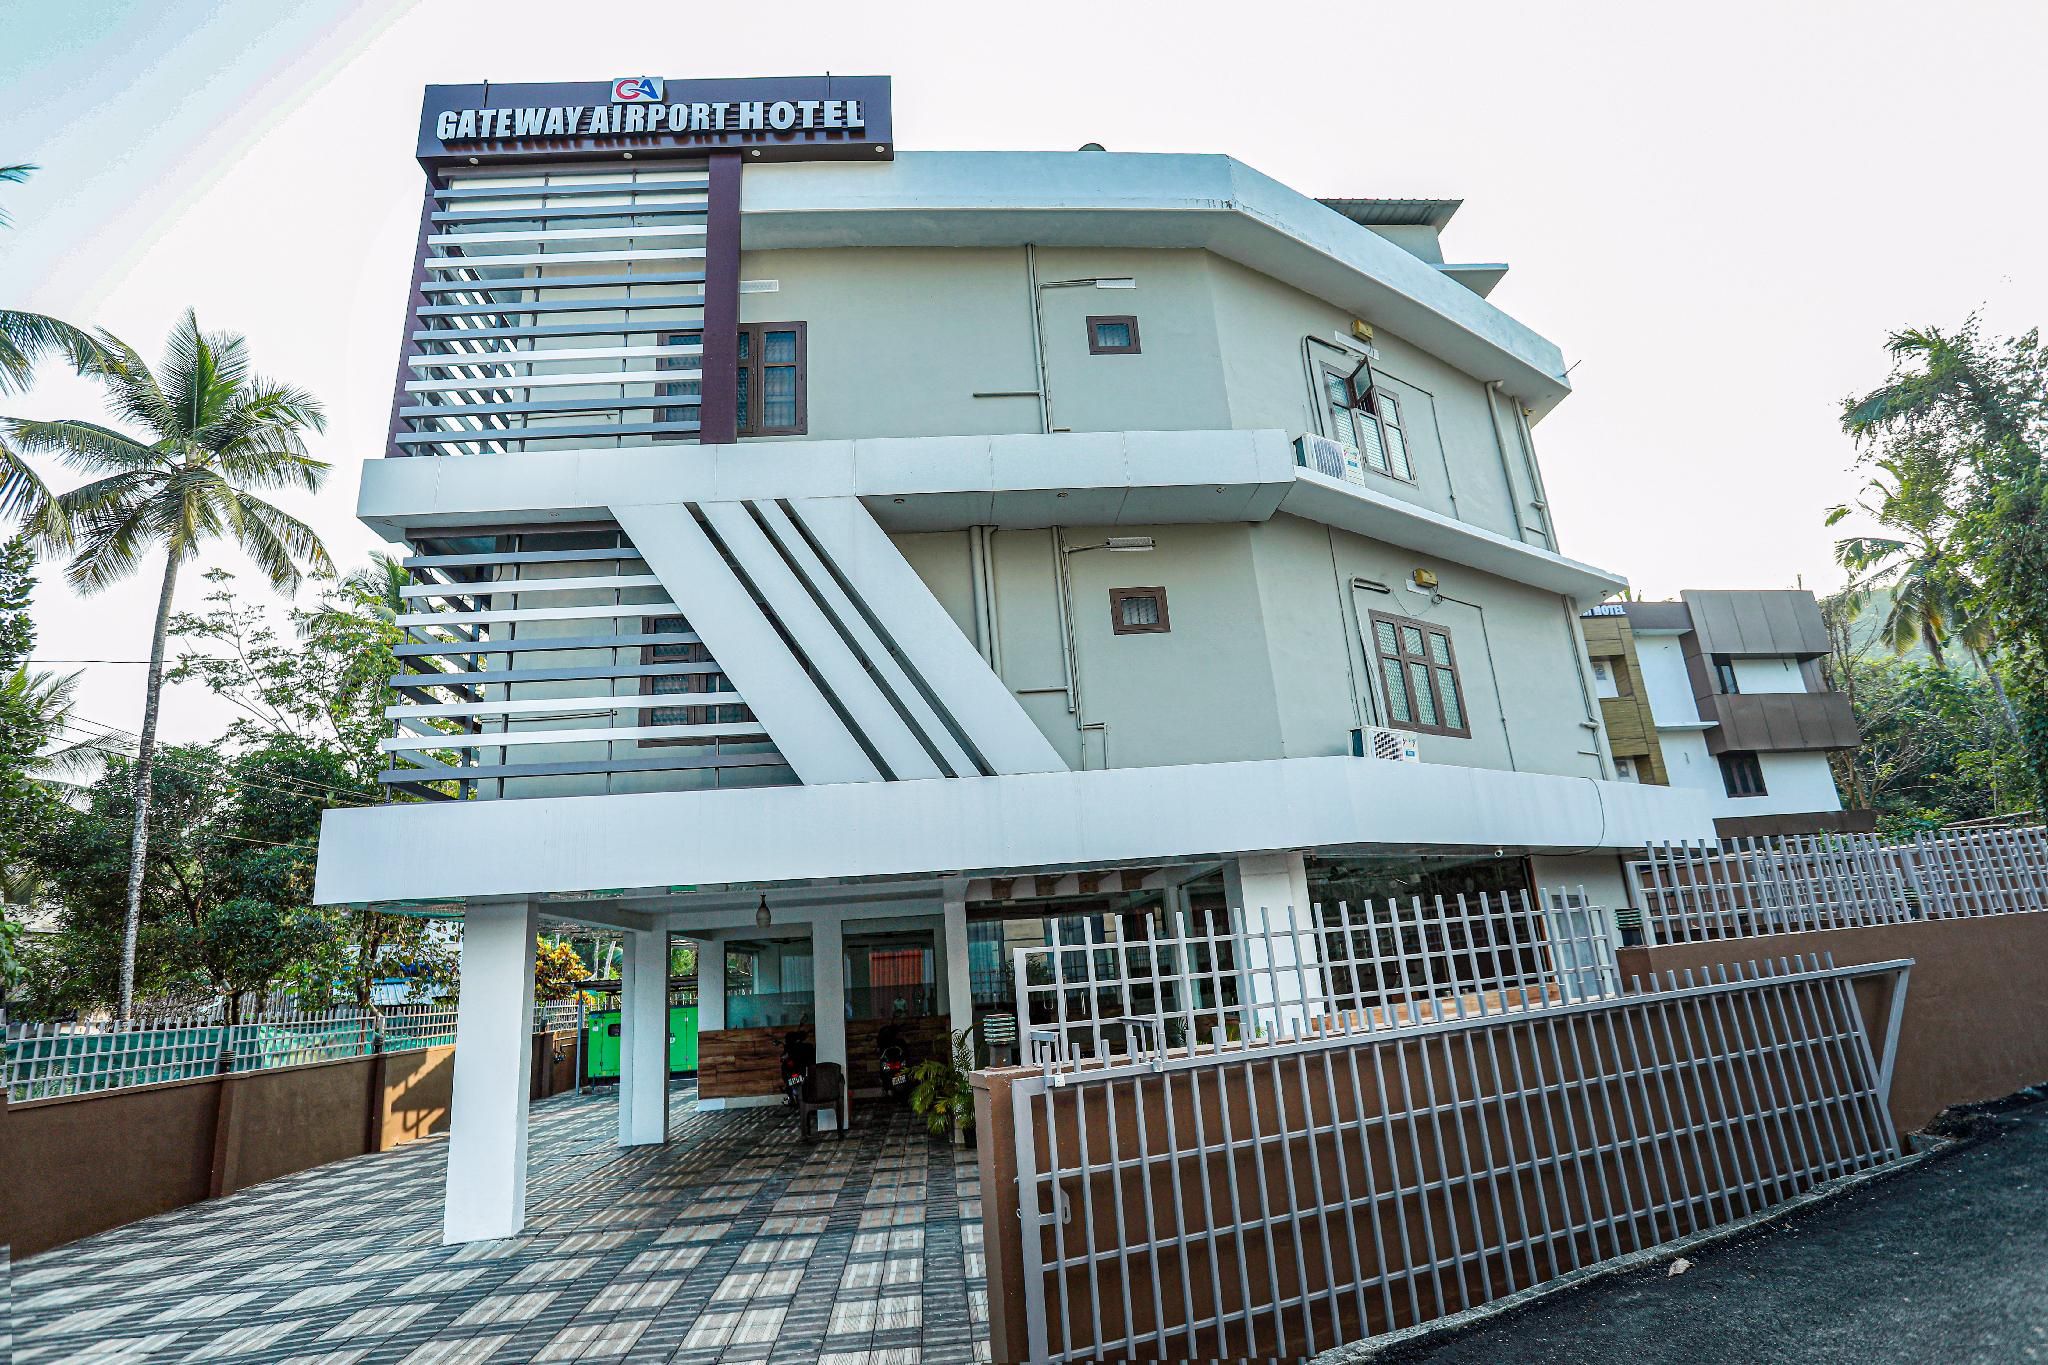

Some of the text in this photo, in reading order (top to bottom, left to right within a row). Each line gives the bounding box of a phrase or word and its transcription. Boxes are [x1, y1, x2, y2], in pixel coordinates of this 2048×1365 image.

[436, 100, 865, 140] GATEWAY AIRPORT HOTEL
